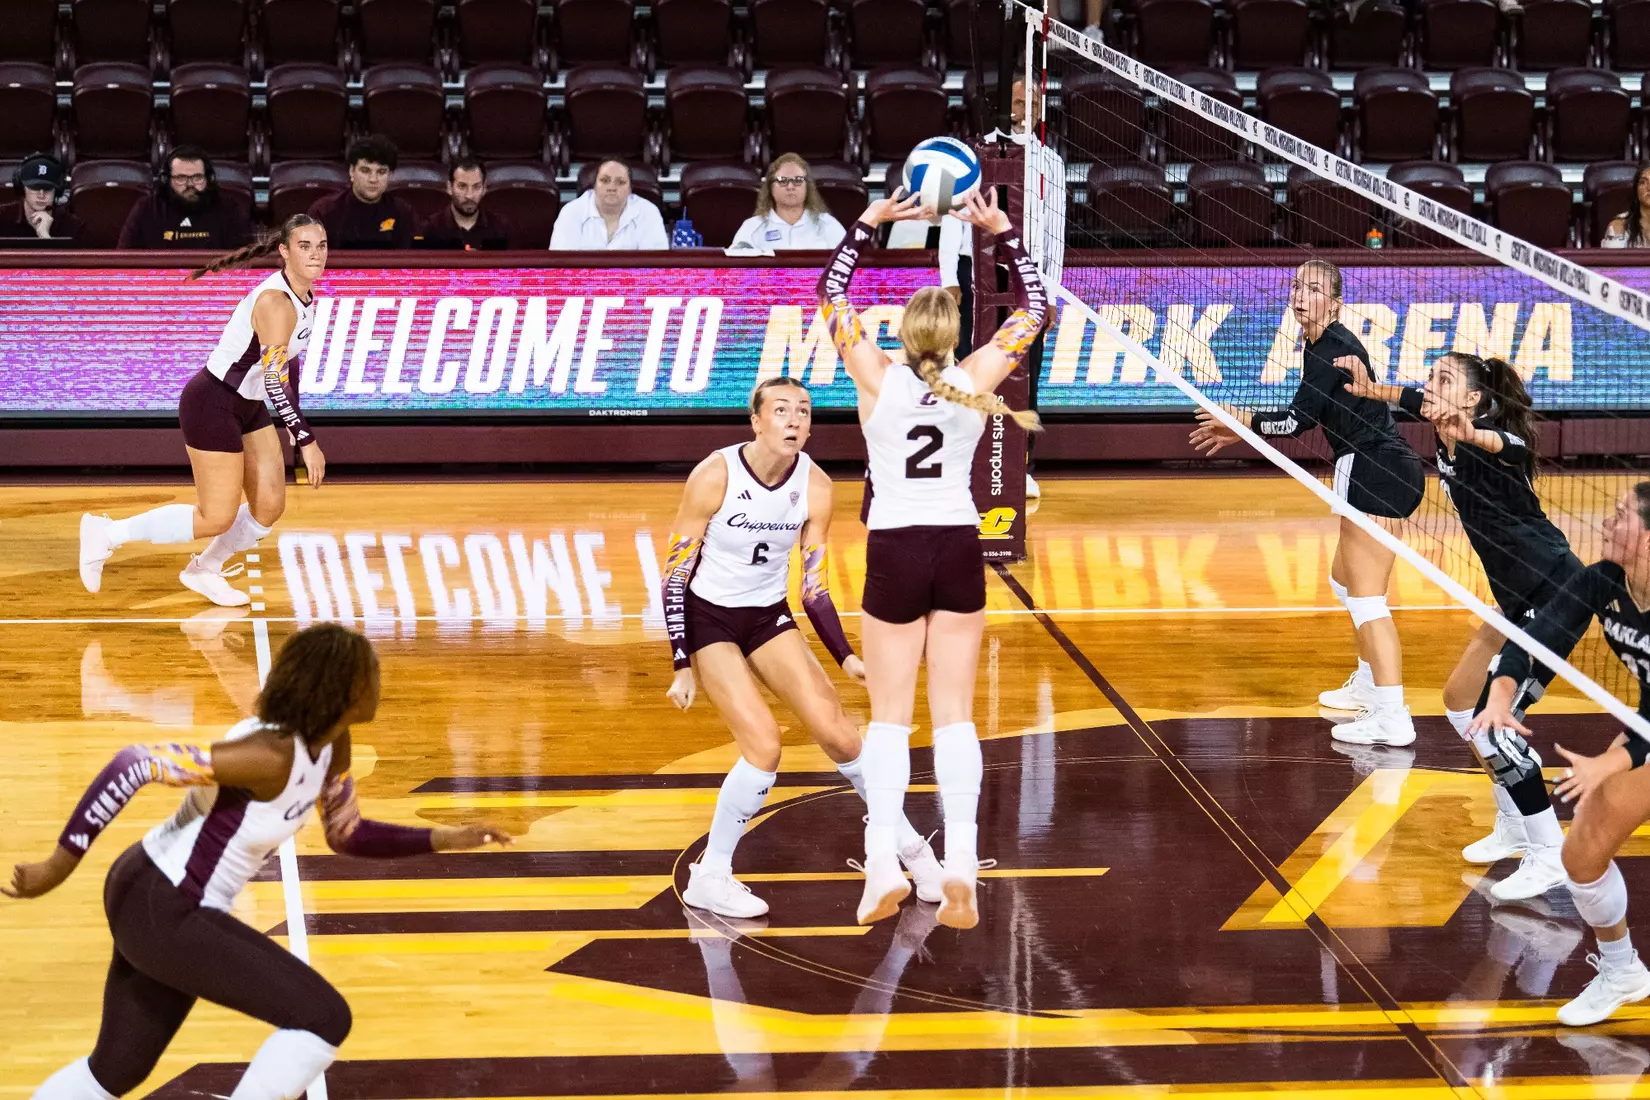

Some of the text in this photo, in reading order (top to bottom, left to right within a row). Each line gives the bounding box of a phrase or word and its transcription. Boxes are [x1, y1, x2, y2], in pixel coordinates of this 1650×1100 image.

[636, 296, 725, 393] TO
[1260, 302, 1574, 385] ARENA
[264, 370, 301, 428] CHIPPEWAS
[993, 395, 1004, 440] sorts
[905, 424, 944, 479] 2
[751, 542, 770, 565] 6
[666, 567, 691, 640] CHIPPEWAS
[84, 756, 163, 829] CHIPPEWAS
